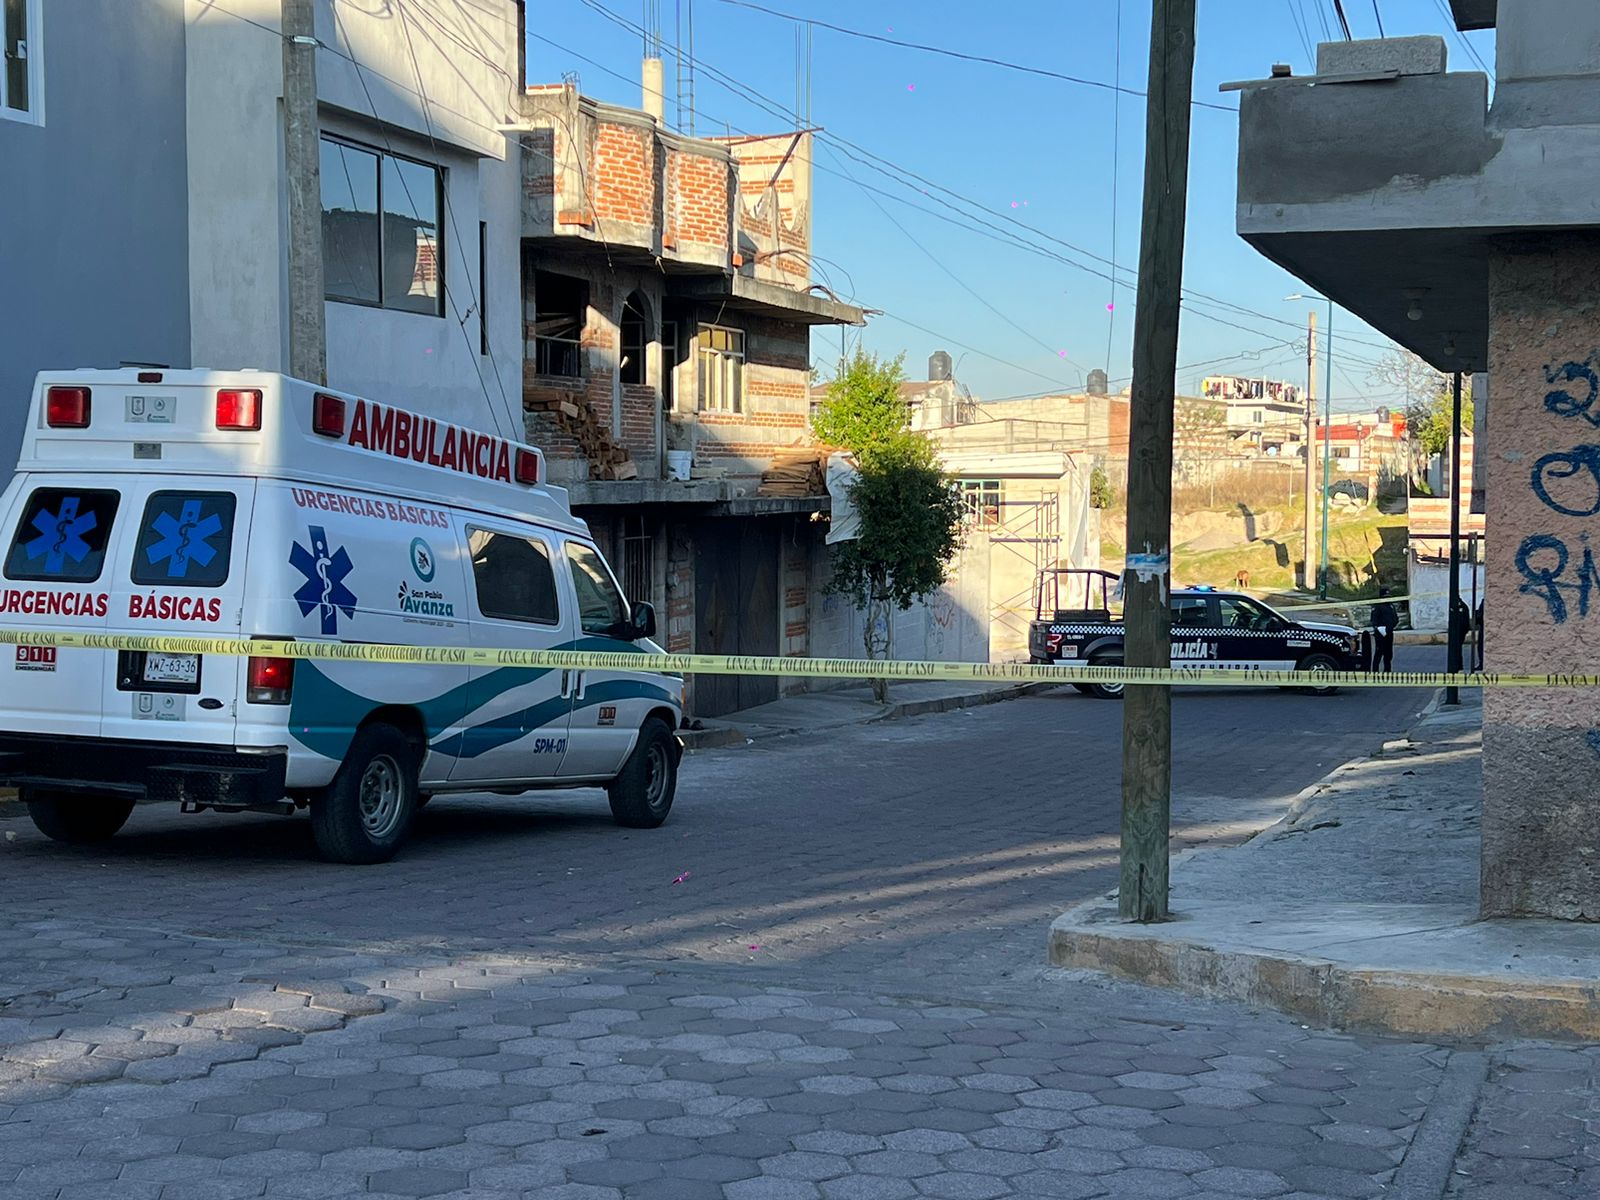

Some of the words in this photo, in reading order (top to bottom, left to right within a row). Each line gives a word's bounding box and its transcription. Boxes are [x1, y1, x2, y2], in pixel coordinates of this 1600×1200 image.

[348, 399, 511, 483] AMBULANCIA
[291, 488, 386, 519] URGENCIAS
[411, 589, 424, 598] San
[425, 590, 443, 599] Pablo
[0, 589, 108, 617] URGENCIAS
[129, 590, 220, 622] BÁSICAS
[403, 595, 454, 617] Avanza
[18, 647, 52, 661] 911
[283, 642, 311, 656] LINEA
[315, 643, 328, 657] DE
[330, 644, 366, 659] POLICIA
[369, 646, 422, 661] PROHIBIDO
[425, 648, 437, 662] EL
[440, 649, 466, 662] PASO
[1170, 638, 1208, 659] OLICÍA
[148, 658, 196, 673] XWZ-63-36
[497, 650, 526, 664] LINEA
[530, 651, 544, 665] DE
[547, 651, 584, 666] POLICIA
[589, 653, 644, 668] PROHIBIDO
[648, 655, 660, 669] EL
[664, 655, 691, 669] PASO
[726, 657, 757, 671] LINEA
[761, 657, 774, 672] DE
[778, 658, 820, 673] POLICIA
[824, 659, 884, 674] PROHIBIDO
[888, 661, 902, 675] EL
[905, 661, 935, 675] PASO
[972, 663, 1006, 676] LINEA
[1011, 664, 1026, 677] DE
[1030, 665, 1075, 678] POLICIA
[1080, 666, 1146, 680] PROHIBIDO
[1244, 670, 1282, 682] LINEA
[533, 738, 566, 753] SPM-01
